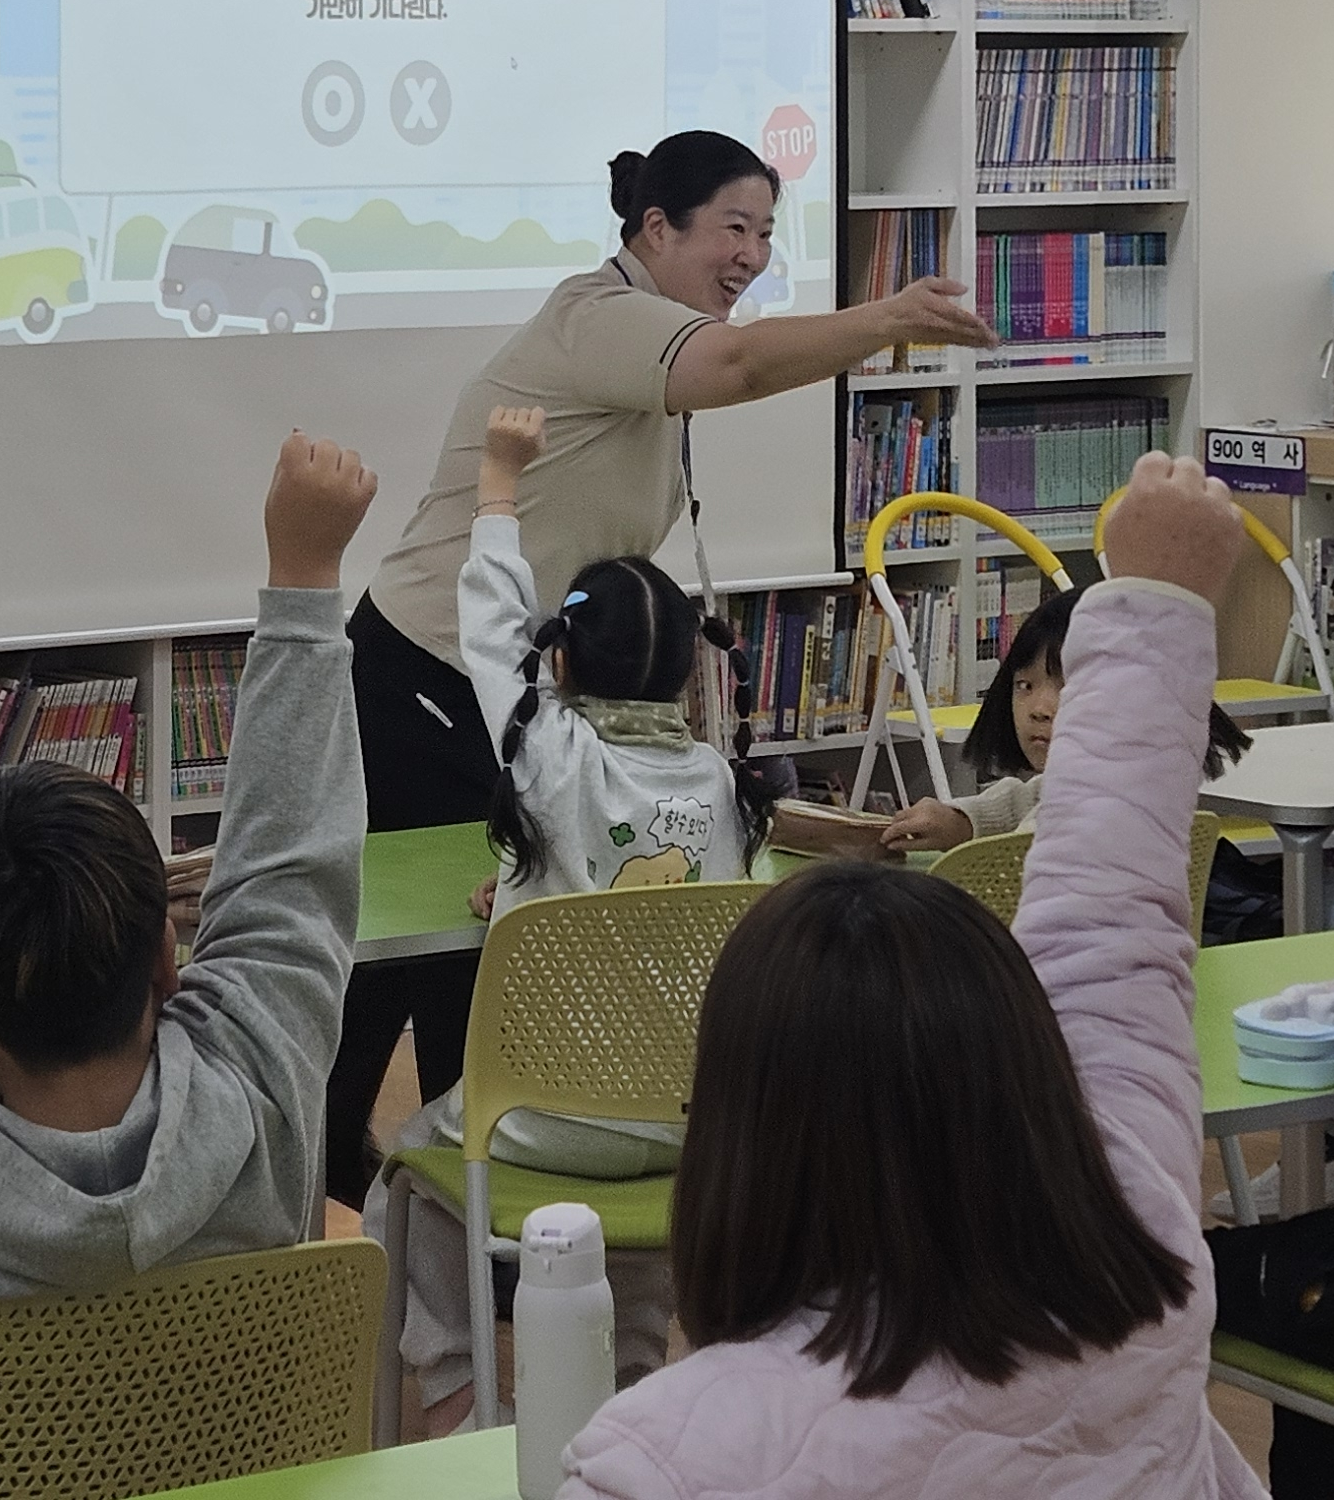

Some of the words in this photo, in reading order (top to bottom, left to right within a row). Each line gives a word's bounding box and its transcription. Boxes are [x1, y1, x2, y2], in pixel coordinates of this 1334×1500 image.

[766, 124, 814, 160] STOP
[1212, 438, 1244, 459] 900
[1251, 440, 1266, 464] 역
[1283, 442, 1299, 466] 사
